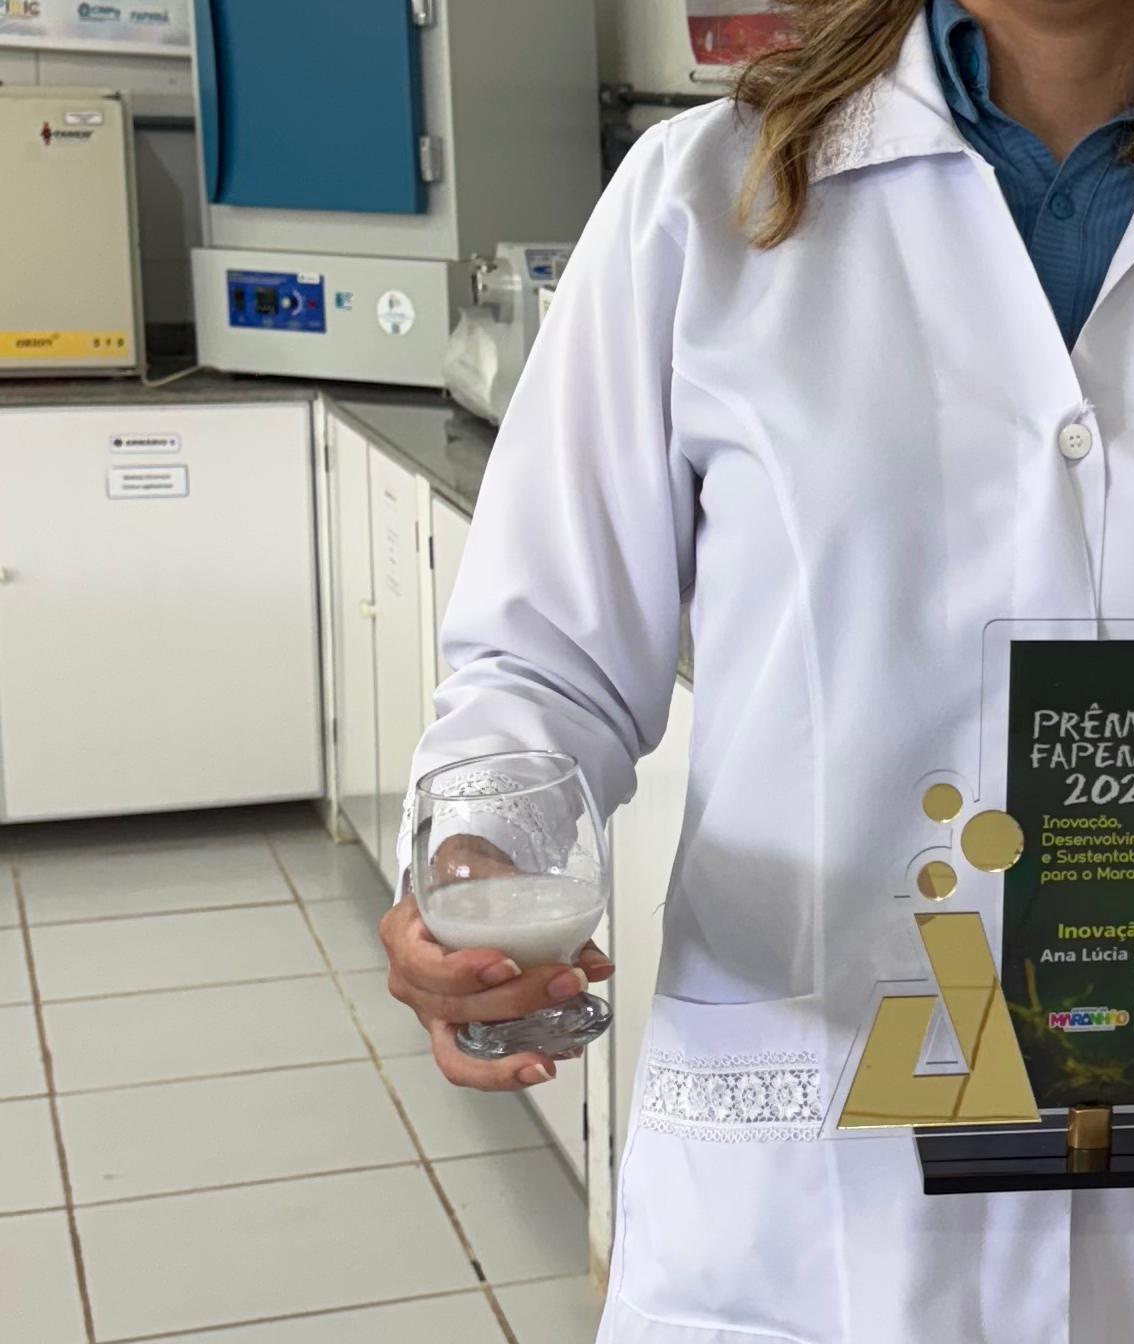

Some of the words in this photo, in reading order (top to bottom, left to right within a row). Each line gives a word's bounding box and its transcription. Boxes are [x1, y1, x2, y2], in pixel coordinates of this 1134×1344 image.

[1042, 815, 1122, 831] Inovação,
[1041, 854, 1051, 864] e
[1040, 869, 1077, 885] para
[1082, 870, 1092, 880] o
[1040, 948, 1076, 963] Ana
[1082, 947, 1128, 962] Lúcia
